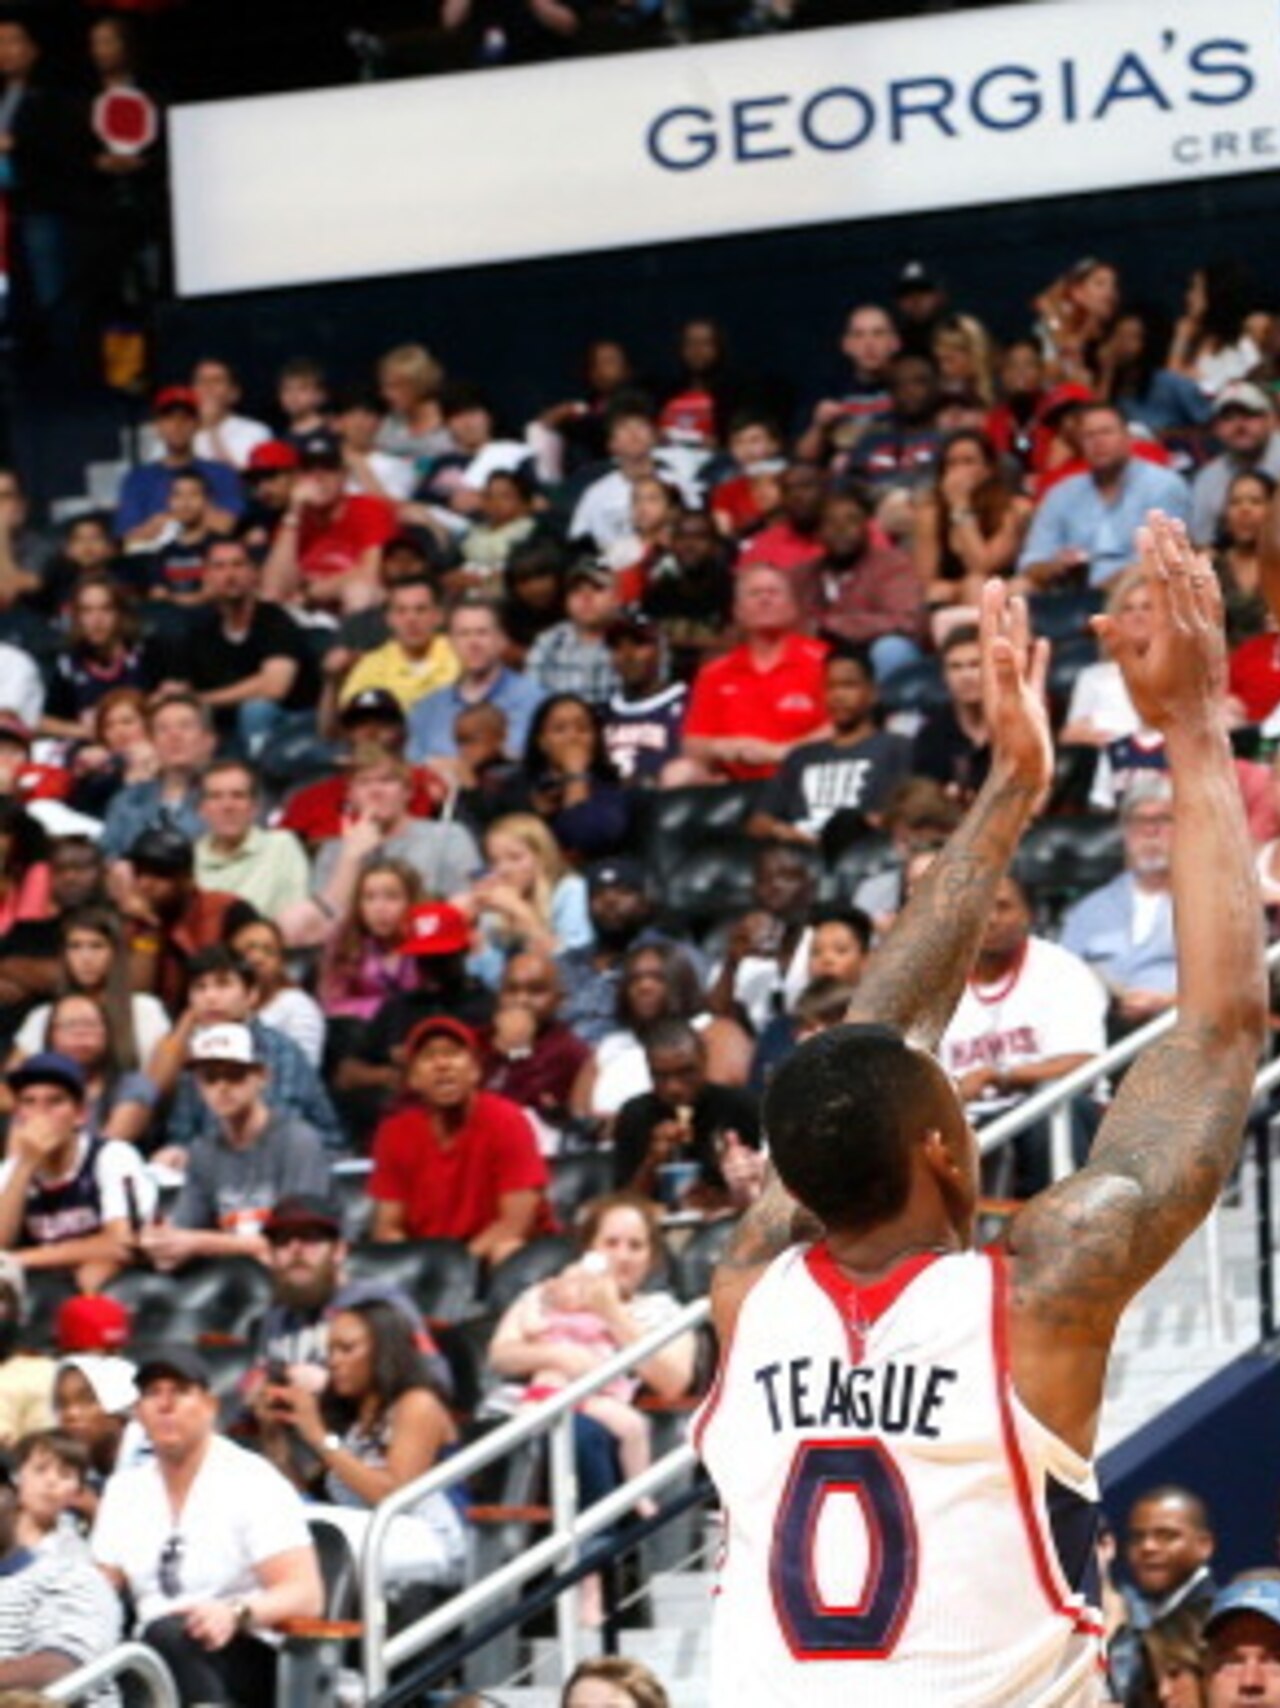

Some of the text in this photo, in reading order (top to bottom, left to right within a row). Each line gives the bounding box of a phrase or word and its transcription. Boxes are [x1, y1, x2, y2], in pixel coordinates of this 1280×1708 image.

[646, 29, 1256, 172] GEORGIA'S
[753, 1355, 959, 1440] TEAGUE
[767, 1436, 921, 1662] 0
